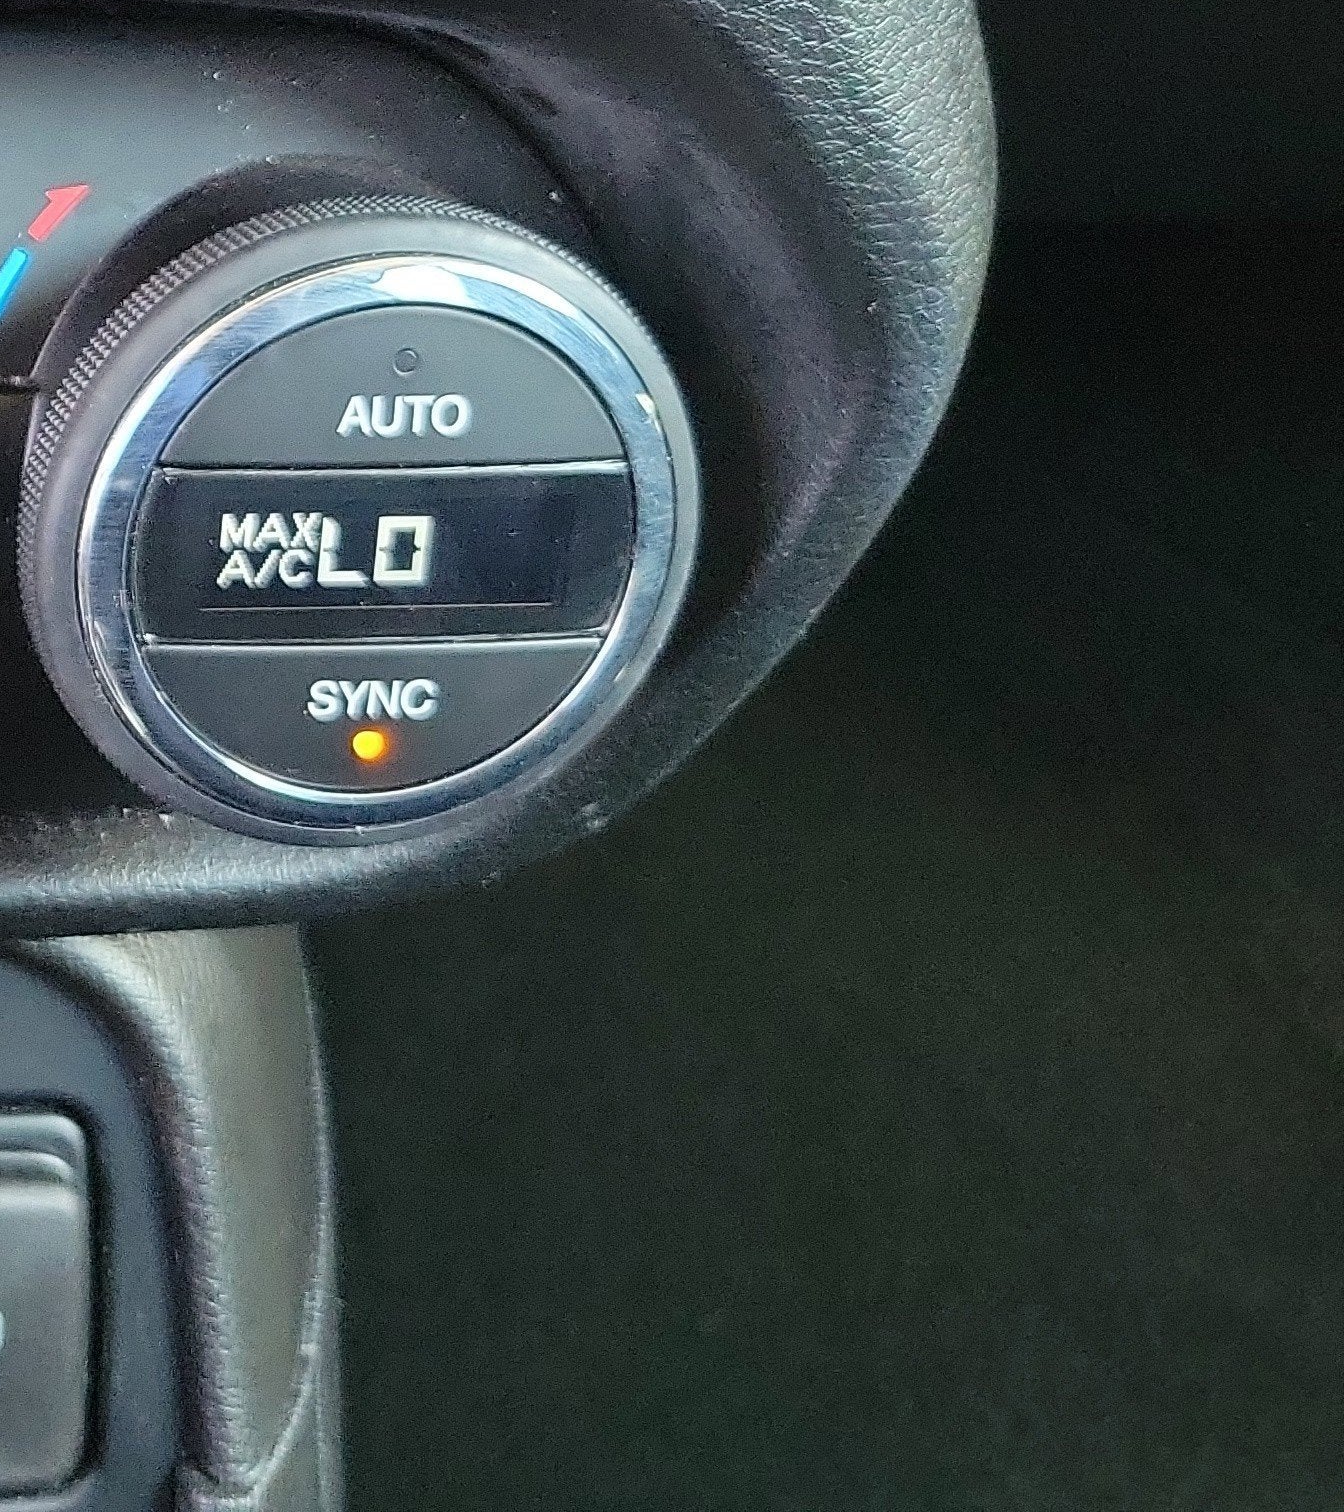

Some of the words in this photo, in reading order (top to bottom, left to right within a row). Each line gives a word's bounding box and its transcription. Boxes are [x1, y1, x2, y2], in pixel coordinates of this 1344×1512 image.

[336, 393, 473, 439] AUTO
[219, 512, 322, 551] MAX
[215, 549, 313, 590] A/C
[307, 678, 442, 722] SYNC
